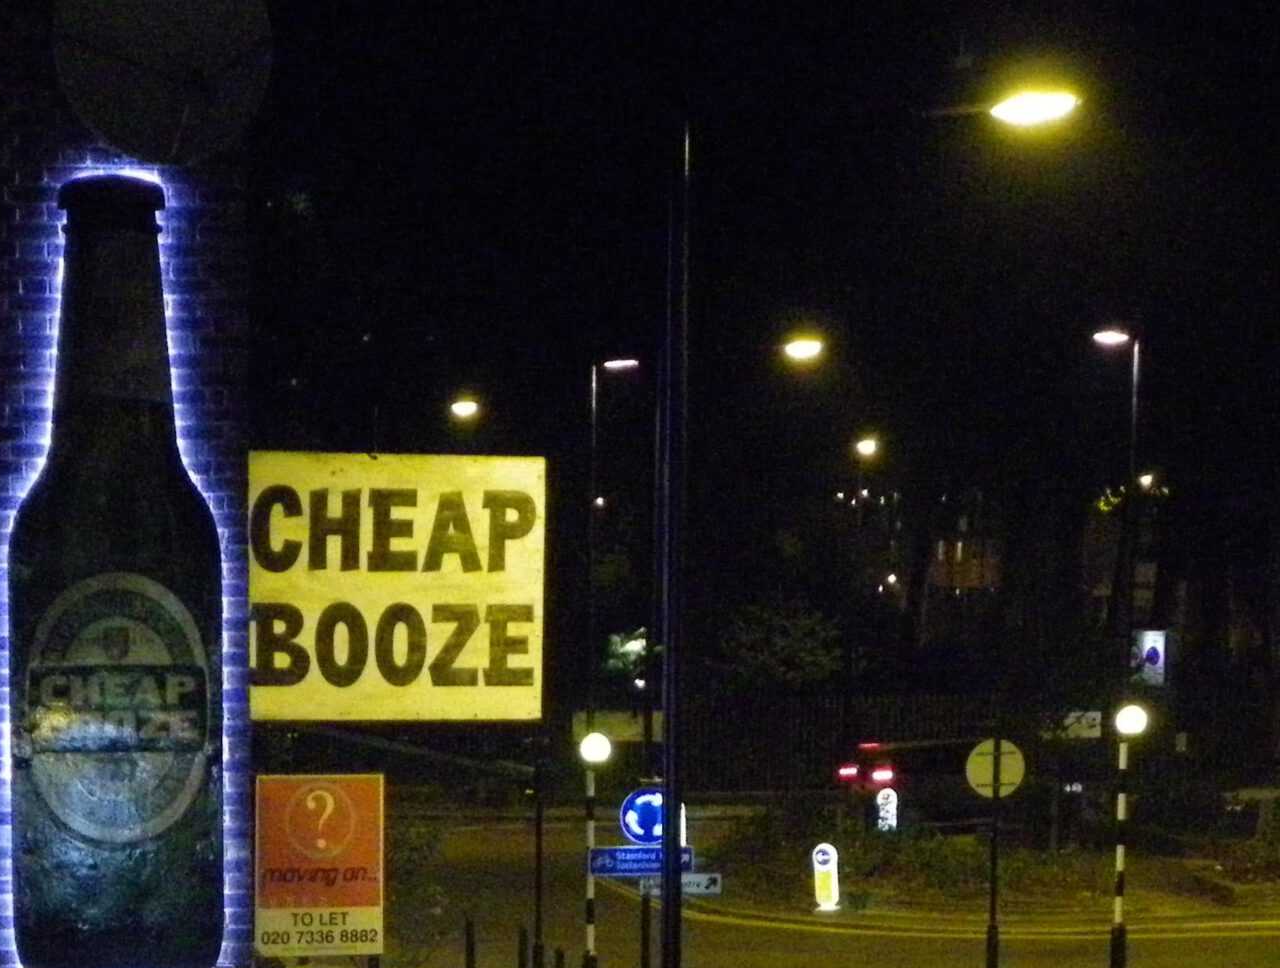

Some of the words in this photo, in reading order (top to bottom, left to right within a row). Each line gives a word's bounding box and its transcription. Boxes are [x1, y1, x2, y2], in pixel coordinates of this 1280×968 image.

[250, 484, 537, 573] CHEAP
[248, 601, 535, 688] BOOZE
[40, 674, 196, 706] CHEAP
[291, 912, 313, 926] TO
[319, 911, 350, 926] LET
[261, 930, 290, 945] 020
[295, 929, 335, 944] 7336
[339, 928, 378, 943] 8882
